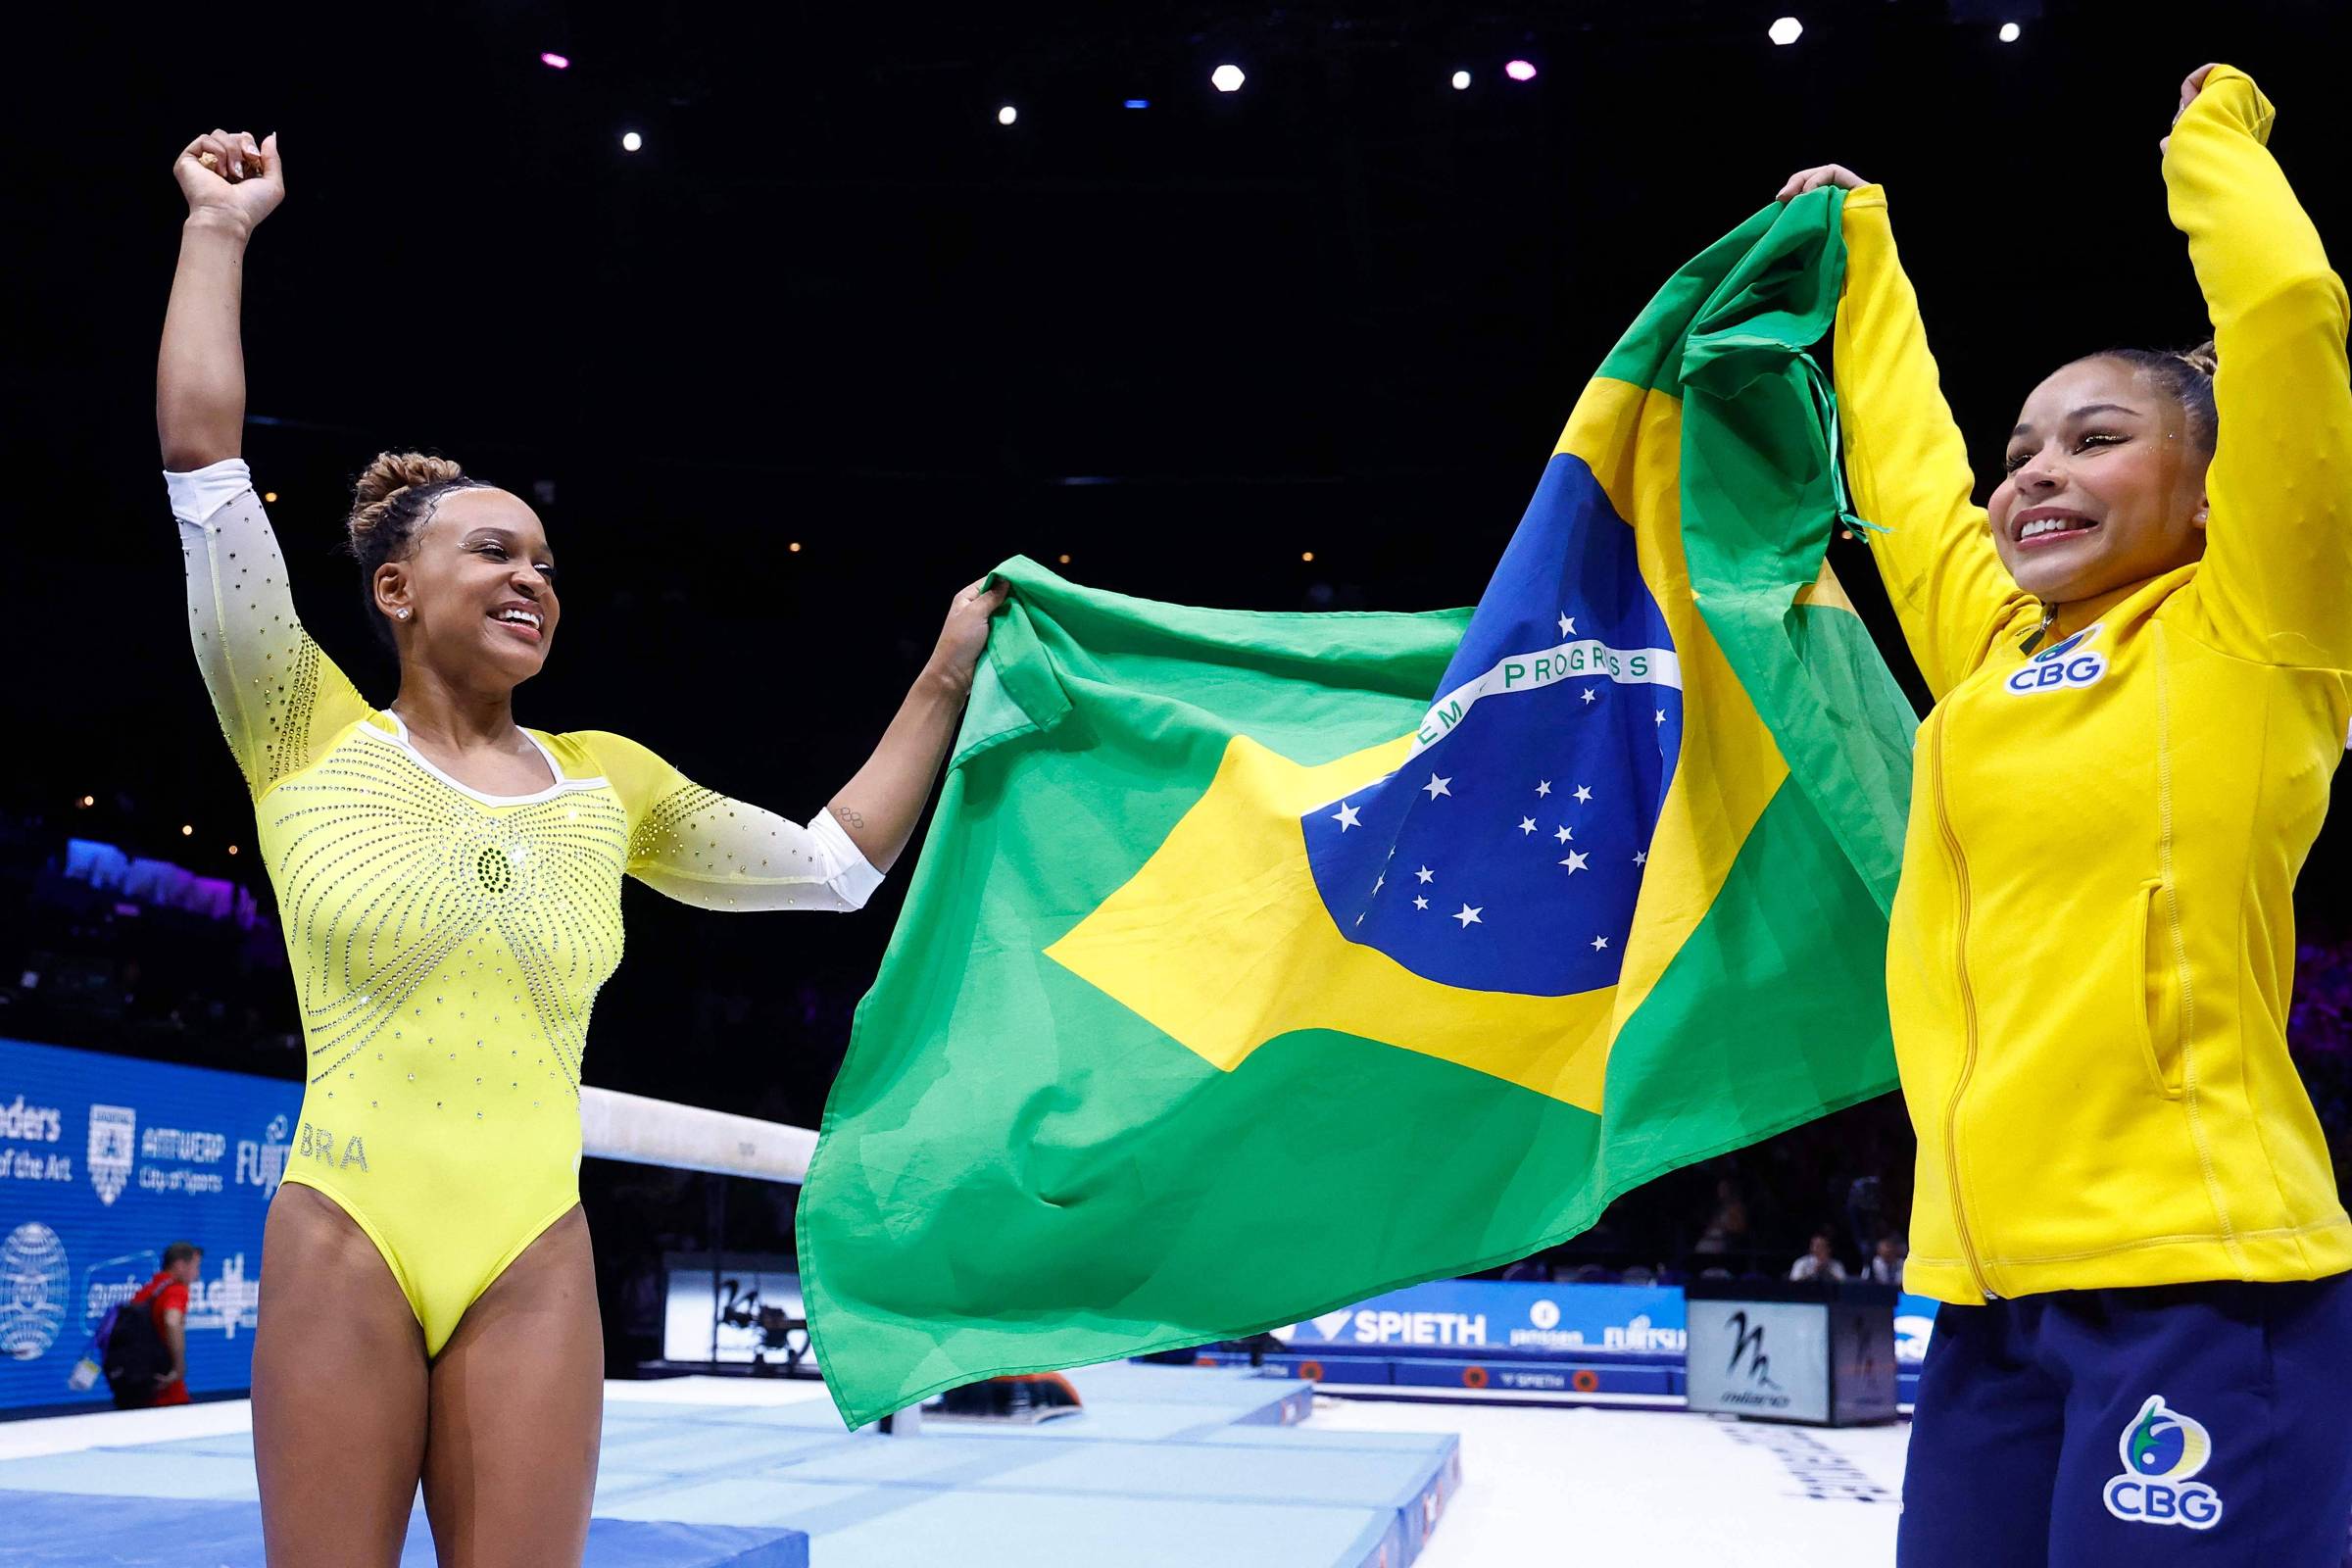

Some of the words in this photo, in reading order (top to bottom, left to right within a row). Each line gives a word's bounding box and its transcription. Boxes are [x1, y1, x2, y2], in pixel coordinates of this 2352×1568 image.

[2010, 656, 2100, 690] CBG
[141, 1127, 226, 1163] ANTWERP
[300, 1122, 368, 1173] BRA
[1354, 1309, 1487, 1346] SPIETH
[2110, 1482, 2217, 1522] CBG
